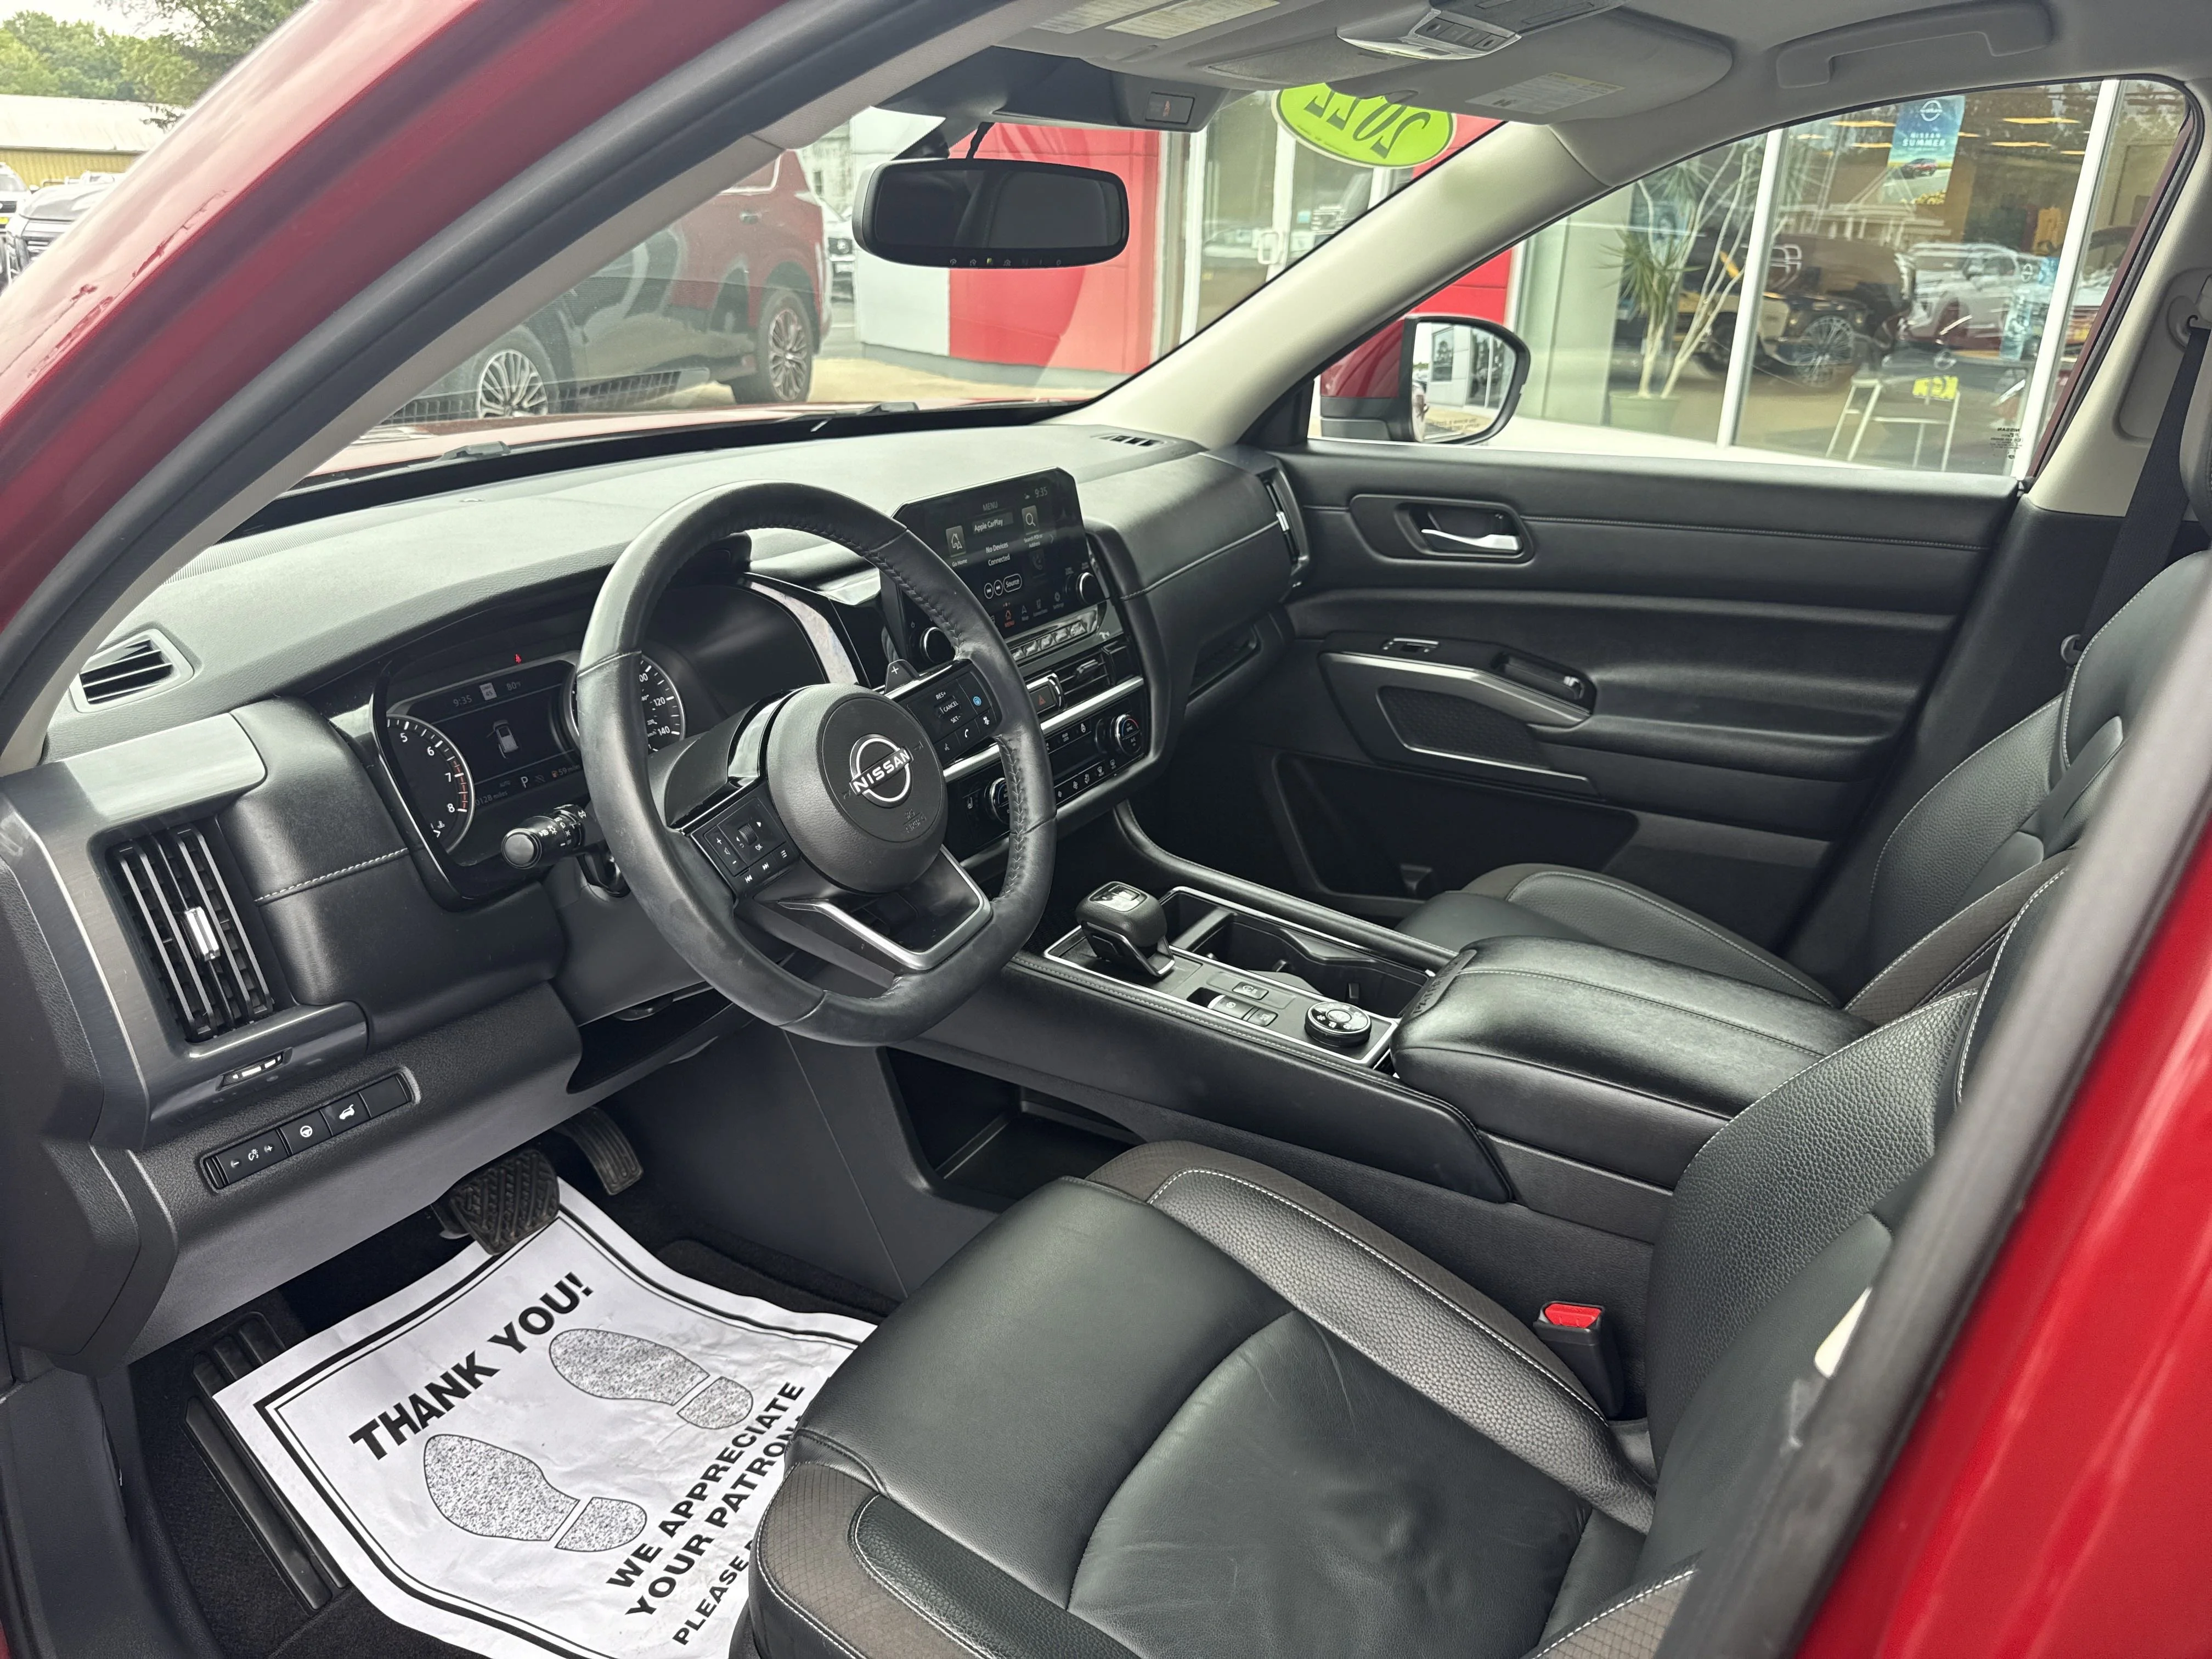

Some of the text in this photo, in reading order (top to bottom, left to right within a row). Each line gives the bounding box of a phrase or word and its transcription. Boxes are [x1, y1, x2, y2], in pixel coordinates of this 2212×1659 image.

[1902, 138, 1946, 146] SUMMER
[1035, 487, 1048, 498] 9:35
[983, 501, 998, 511] MENU
[974, 518, 1003, 533] Apple CarPlay
[993, 542, 1009, 551] Devices
[988, 554, 1011, 566] Connected
[1005, 579, 1020, 588] Source
[639, 673, 648, 682] 00
[453, 695, 472, 707] 9:35
[653, 696, 666, 707] 120
[943, 701, 959, 712] CANCEL
[658, 725, 670, 736] 140
[400, 732, 408, 742] 5
[427, 746, 435, 756] 6
[557, 767, 567, 776] 59
[853, 749, 910, 792] NISSAN
[444, 772, 452, 782] 7
[521, 776, 528, 788] P
[447, 803, 455, 812] 8
[348, 1271, 594, 1460] THANK YOU!
[606, 1381, 805, 1587] WE APPRECIATE
[624, 1534, 715, 1615] YOUR
[672, 1555, 749, 1645] PLEASE
